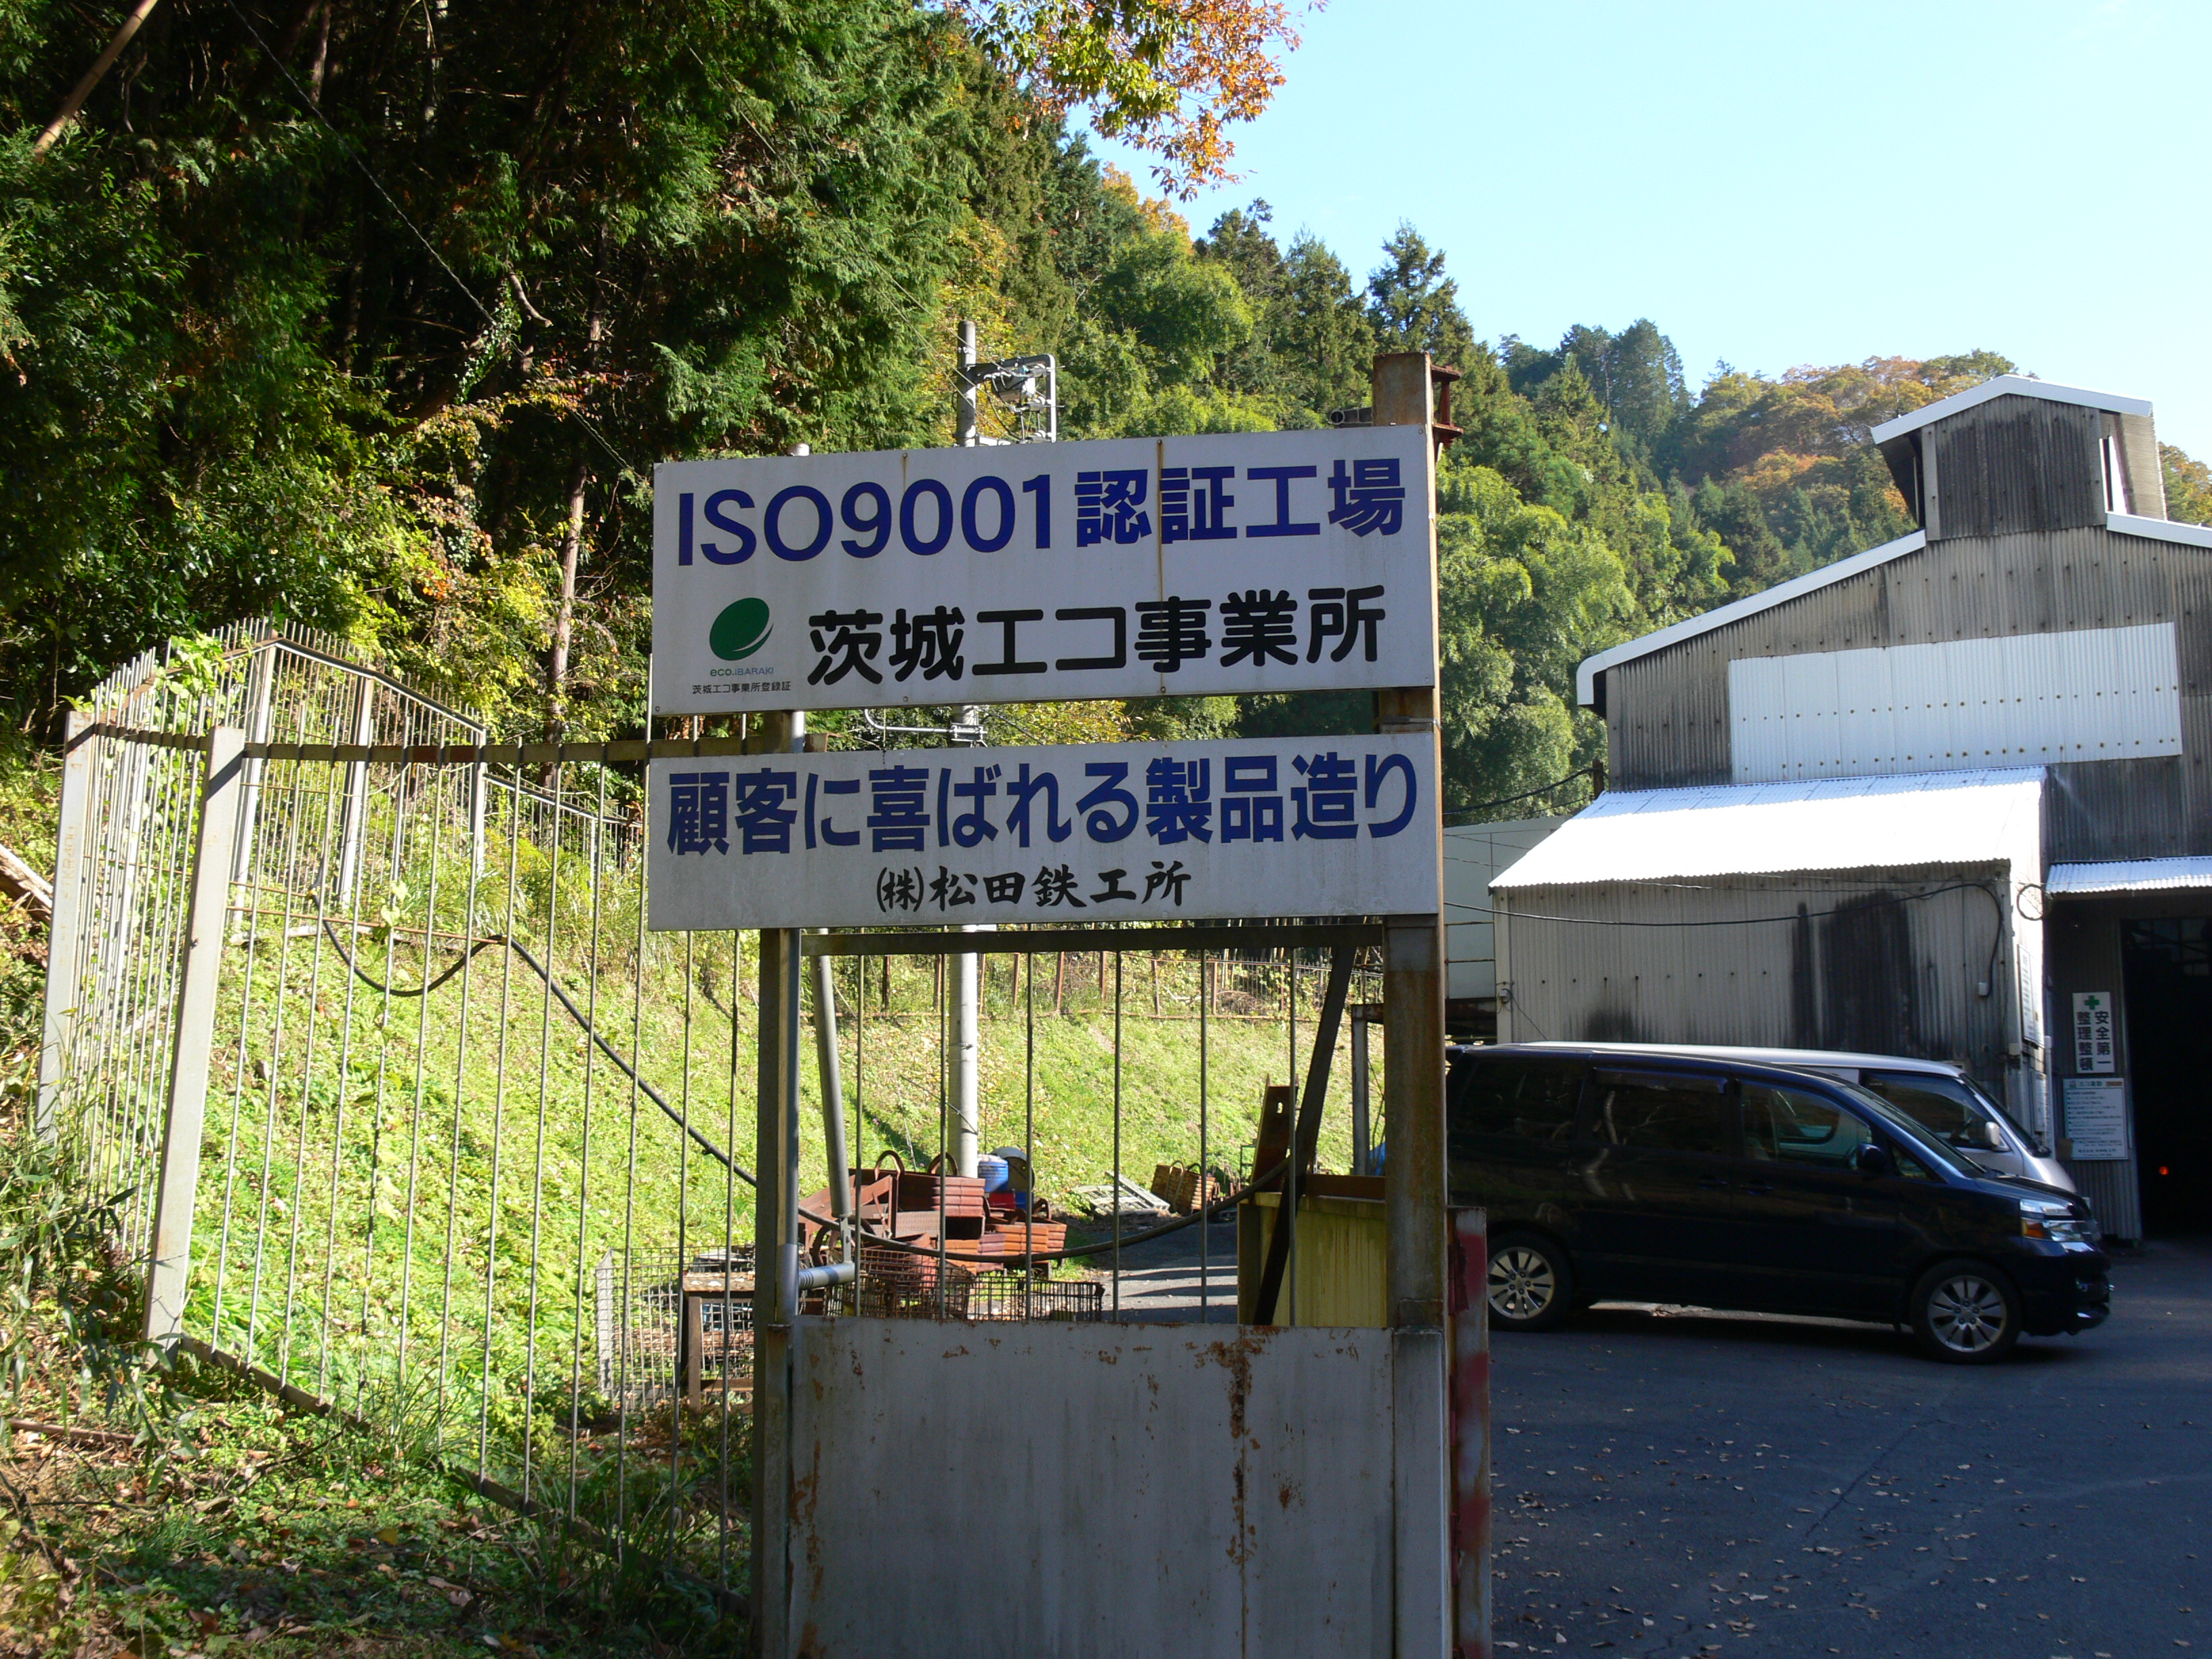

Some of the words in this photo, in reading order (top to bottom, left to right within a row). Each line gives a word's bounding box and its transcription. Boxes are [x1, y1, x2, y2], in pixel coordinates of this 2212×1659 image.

[678, 458, 1406, 567] ISO9001認証工場
[807, 584, 1386, 686] 茨城エコ事業所
[691, 681, 792, 695] 茨城エコ事業所登録証
[667, 752, 1418, 857] 顧客に喜ばれる製品造り
[2076, 1010, 2093, 1071] 整理整頓
[2094, 1010, 2112, 1064] 安全第一
